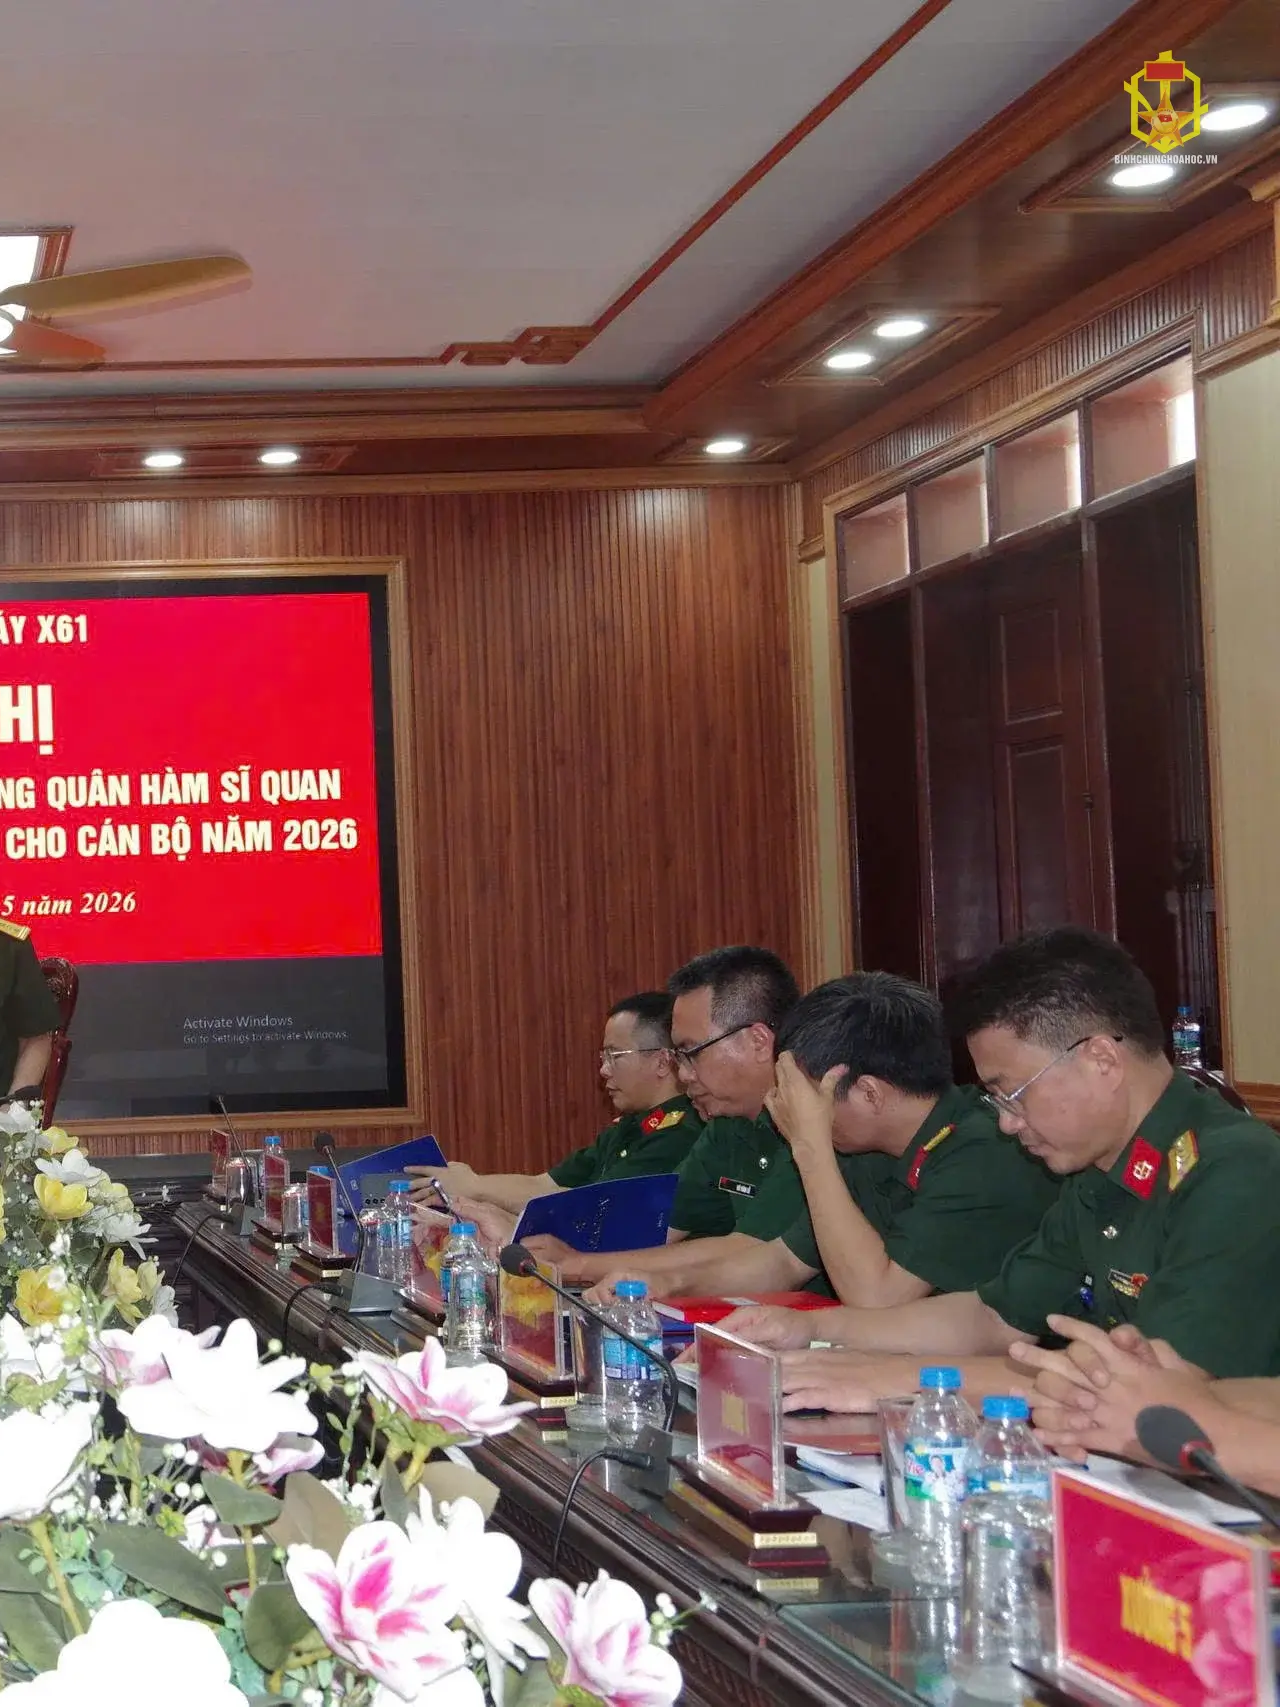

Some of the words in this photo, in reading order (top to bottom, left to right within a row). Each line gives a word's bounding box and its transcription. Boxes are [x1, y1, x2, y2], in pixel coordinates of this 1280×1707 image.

[37, 615, 88, 643] X61
[47, 769, 130, 811] QUÂN
[141, 767, 209, 805] HÀM
[221, 765, 250, 803] SĨ
[261, 769, 341, 803] QUAN
[6, 826, 66, 859] CHO
[78, 818, 140, 857] CÁN
[151, 816, 191, 861] BỘ
[202, 815, 272, 853] NĂM
[284, 818, 357, 850] 2026
[1, 896, 15, 916] 5
[22, 896, 72, 915] năm
[80, 892, 136, 914] 2026
[183, 1017, 233, 1029] Activate
[236, 1015, 294, 1027] Windows
